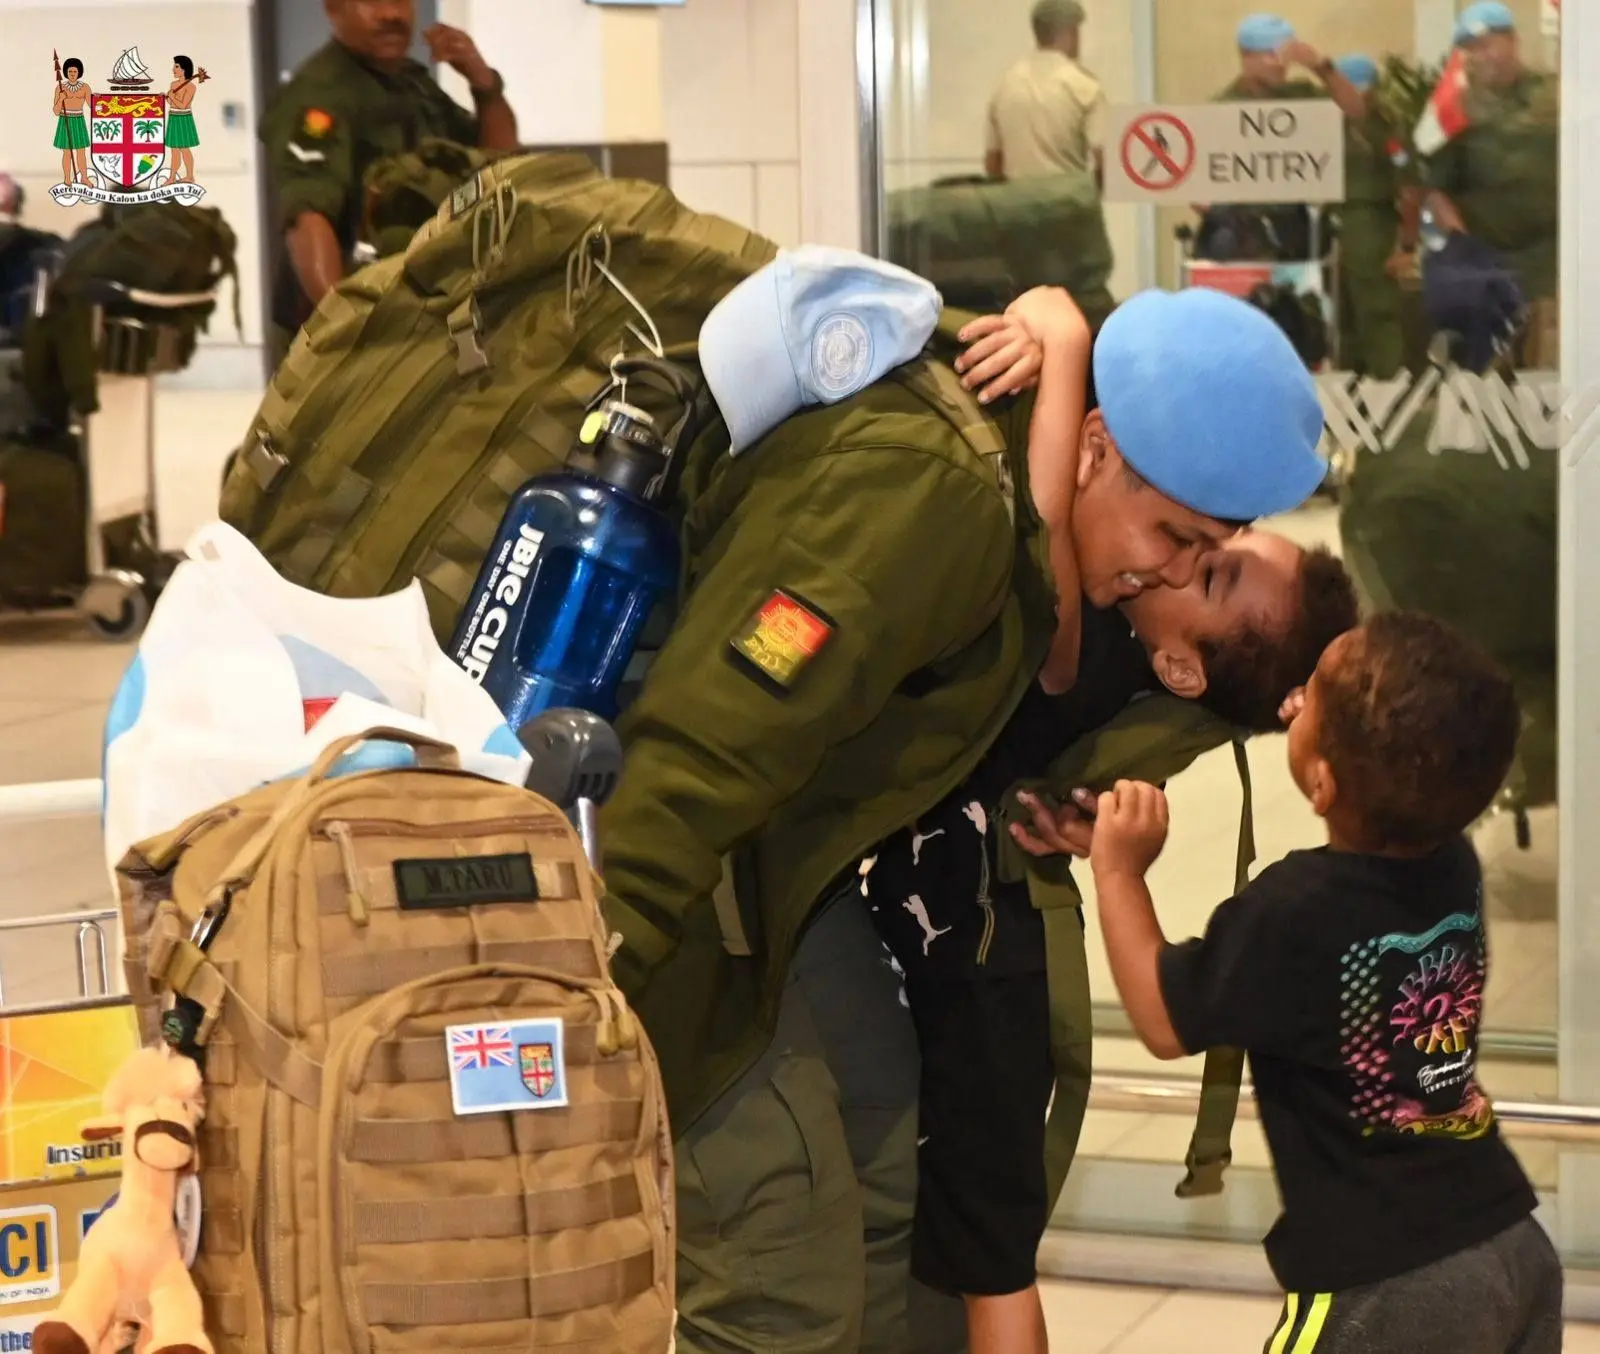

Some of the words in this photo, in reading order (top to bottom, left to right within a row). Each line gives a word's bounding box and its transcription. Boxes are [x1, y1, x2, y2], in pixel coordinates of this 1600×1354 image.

[1239, 108, 1297, 138] NO
[1208, 152, 1331, 183] ENTRY
[497, 540, 513, 565] ONE
[488, 565, 503, 592] DAY
[476, 591, 491, 618] ONE
[457, 616, 480, 659] BOTTLE
[463, 607, 507, 685] CUP
